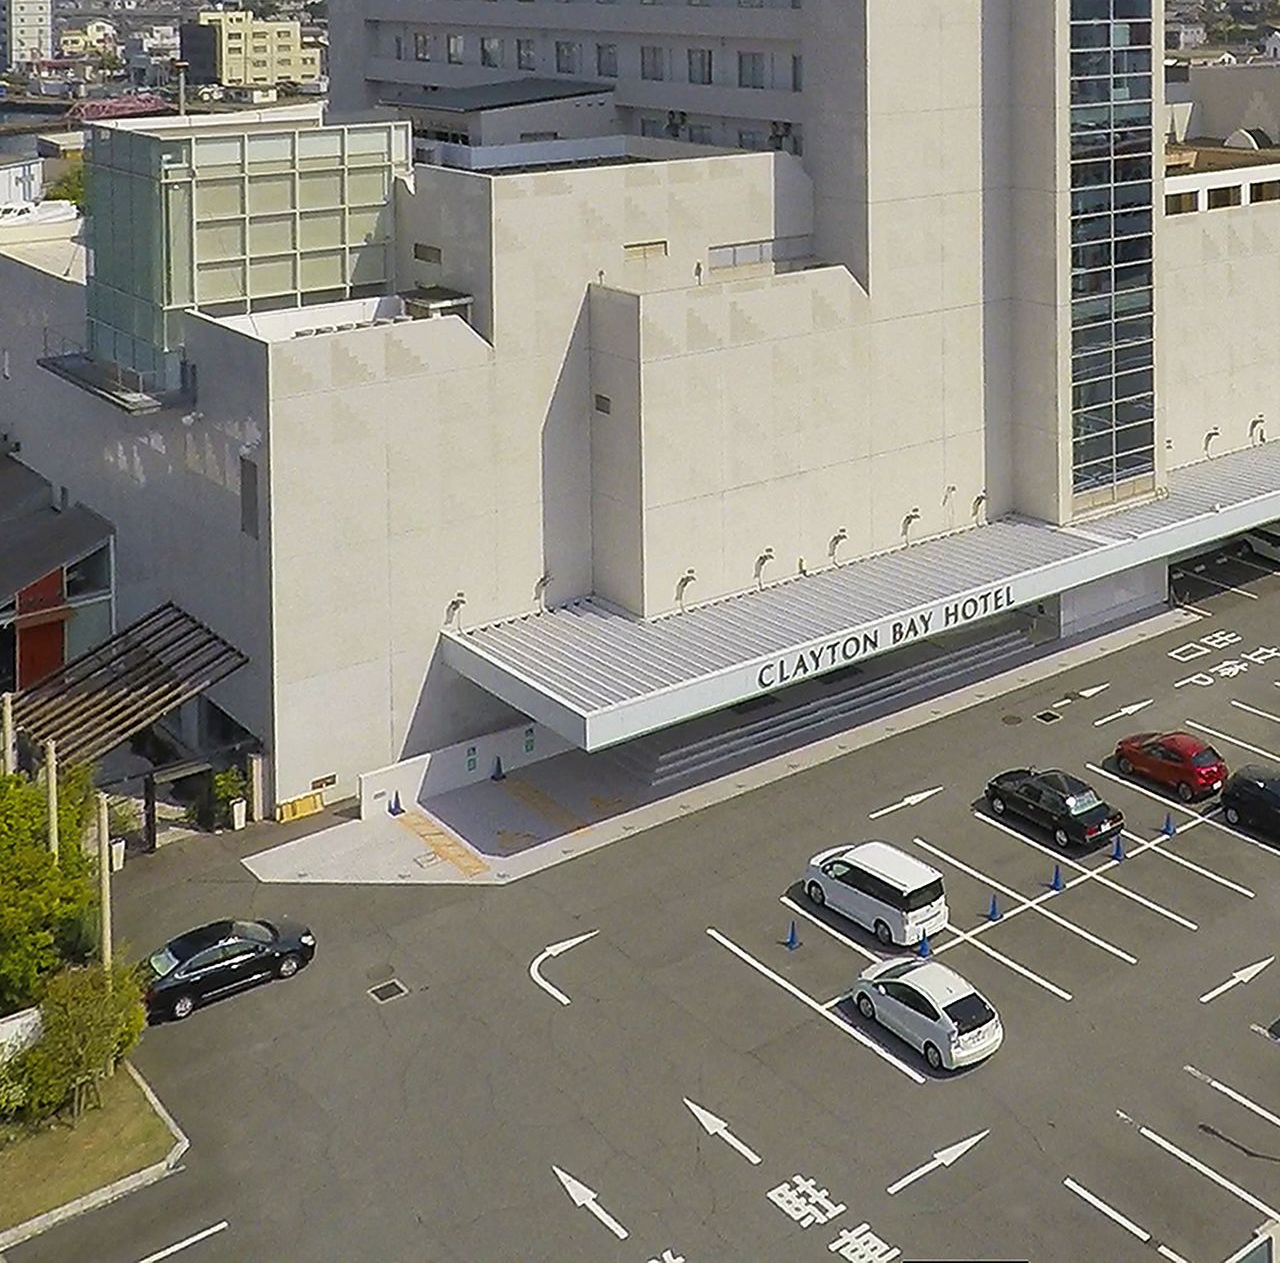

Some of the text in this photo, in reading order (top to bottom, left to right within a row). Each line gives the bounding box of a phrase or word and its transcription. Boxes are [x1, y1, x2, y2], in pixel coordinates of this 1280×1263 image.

[757, 585, 1016, 689] CLAYTON BAY HOTEL
[1167, 630, 1243, 663] 出口
